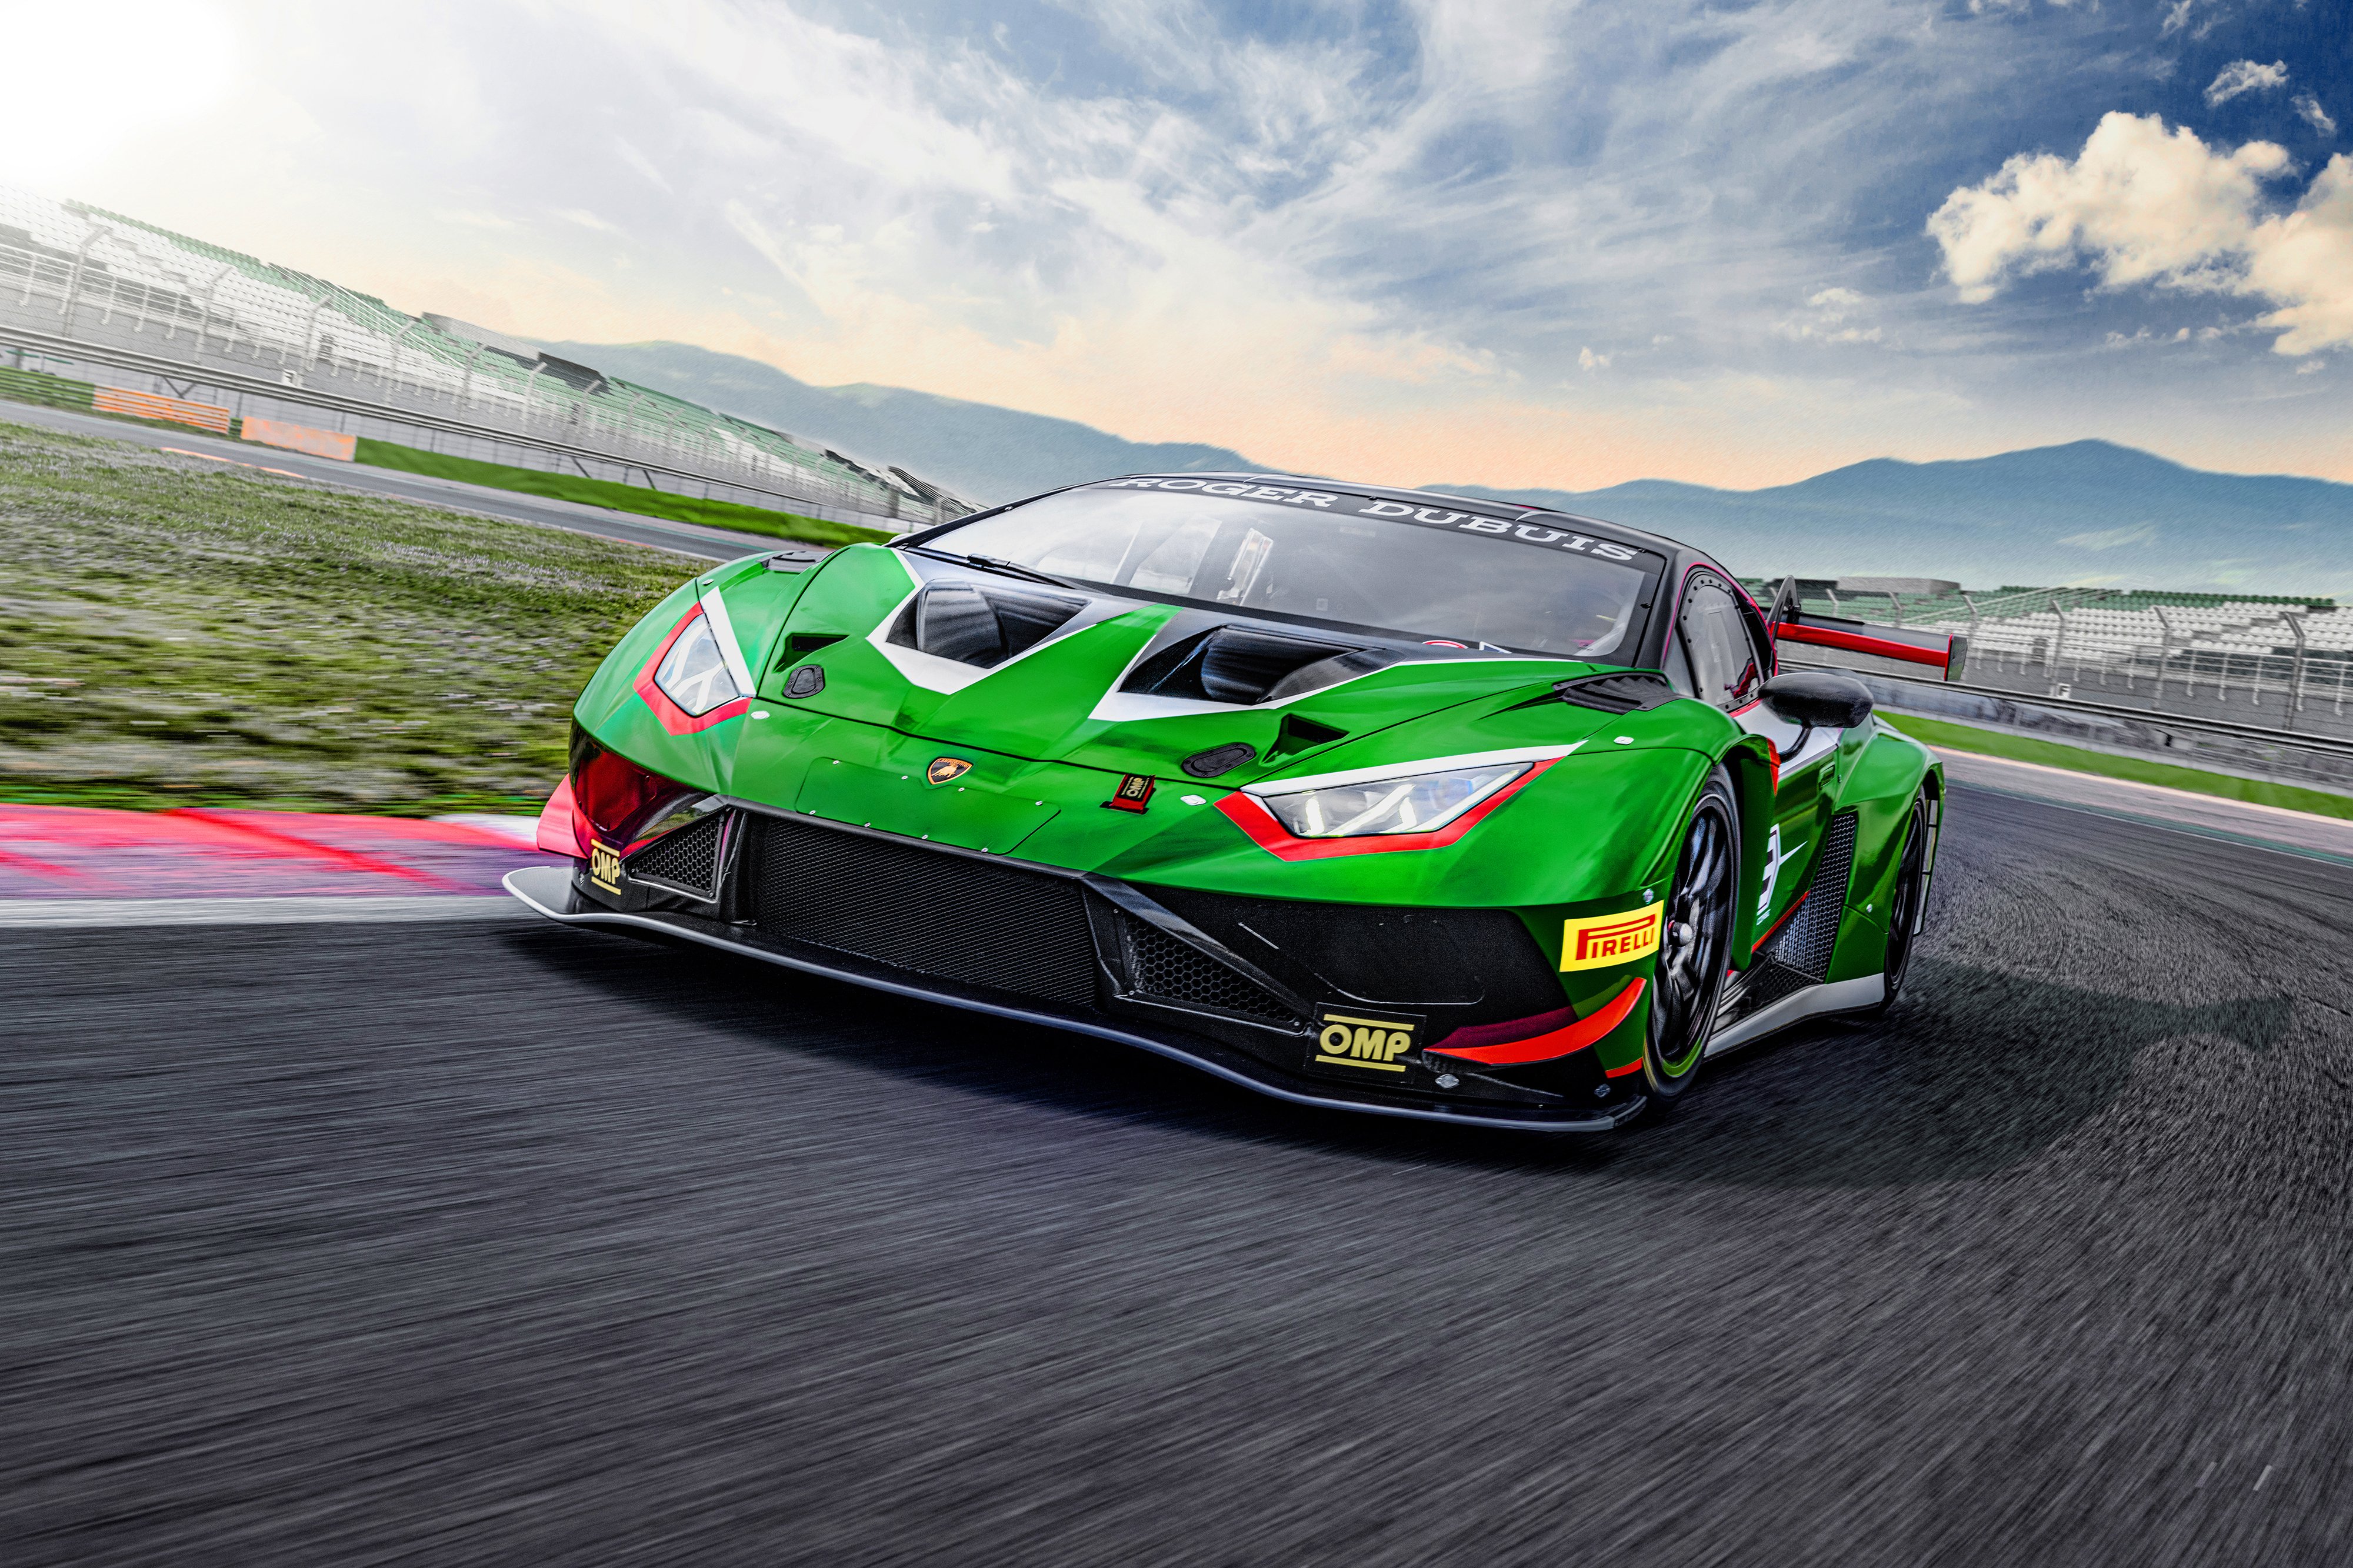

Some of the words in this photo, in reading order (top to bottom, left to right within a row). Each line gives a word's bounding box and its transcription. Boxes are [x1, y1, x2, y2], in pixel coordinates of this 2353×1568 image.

[1108, 478, 1338, 508] ROGER
[1358, 500, 1638, 561] DUBUIS
[591, 848, 621, 885] OMP
[1575, 913, 1655, 960] PIRELLI
[1319, 1024, 1411, 1061] OMP
